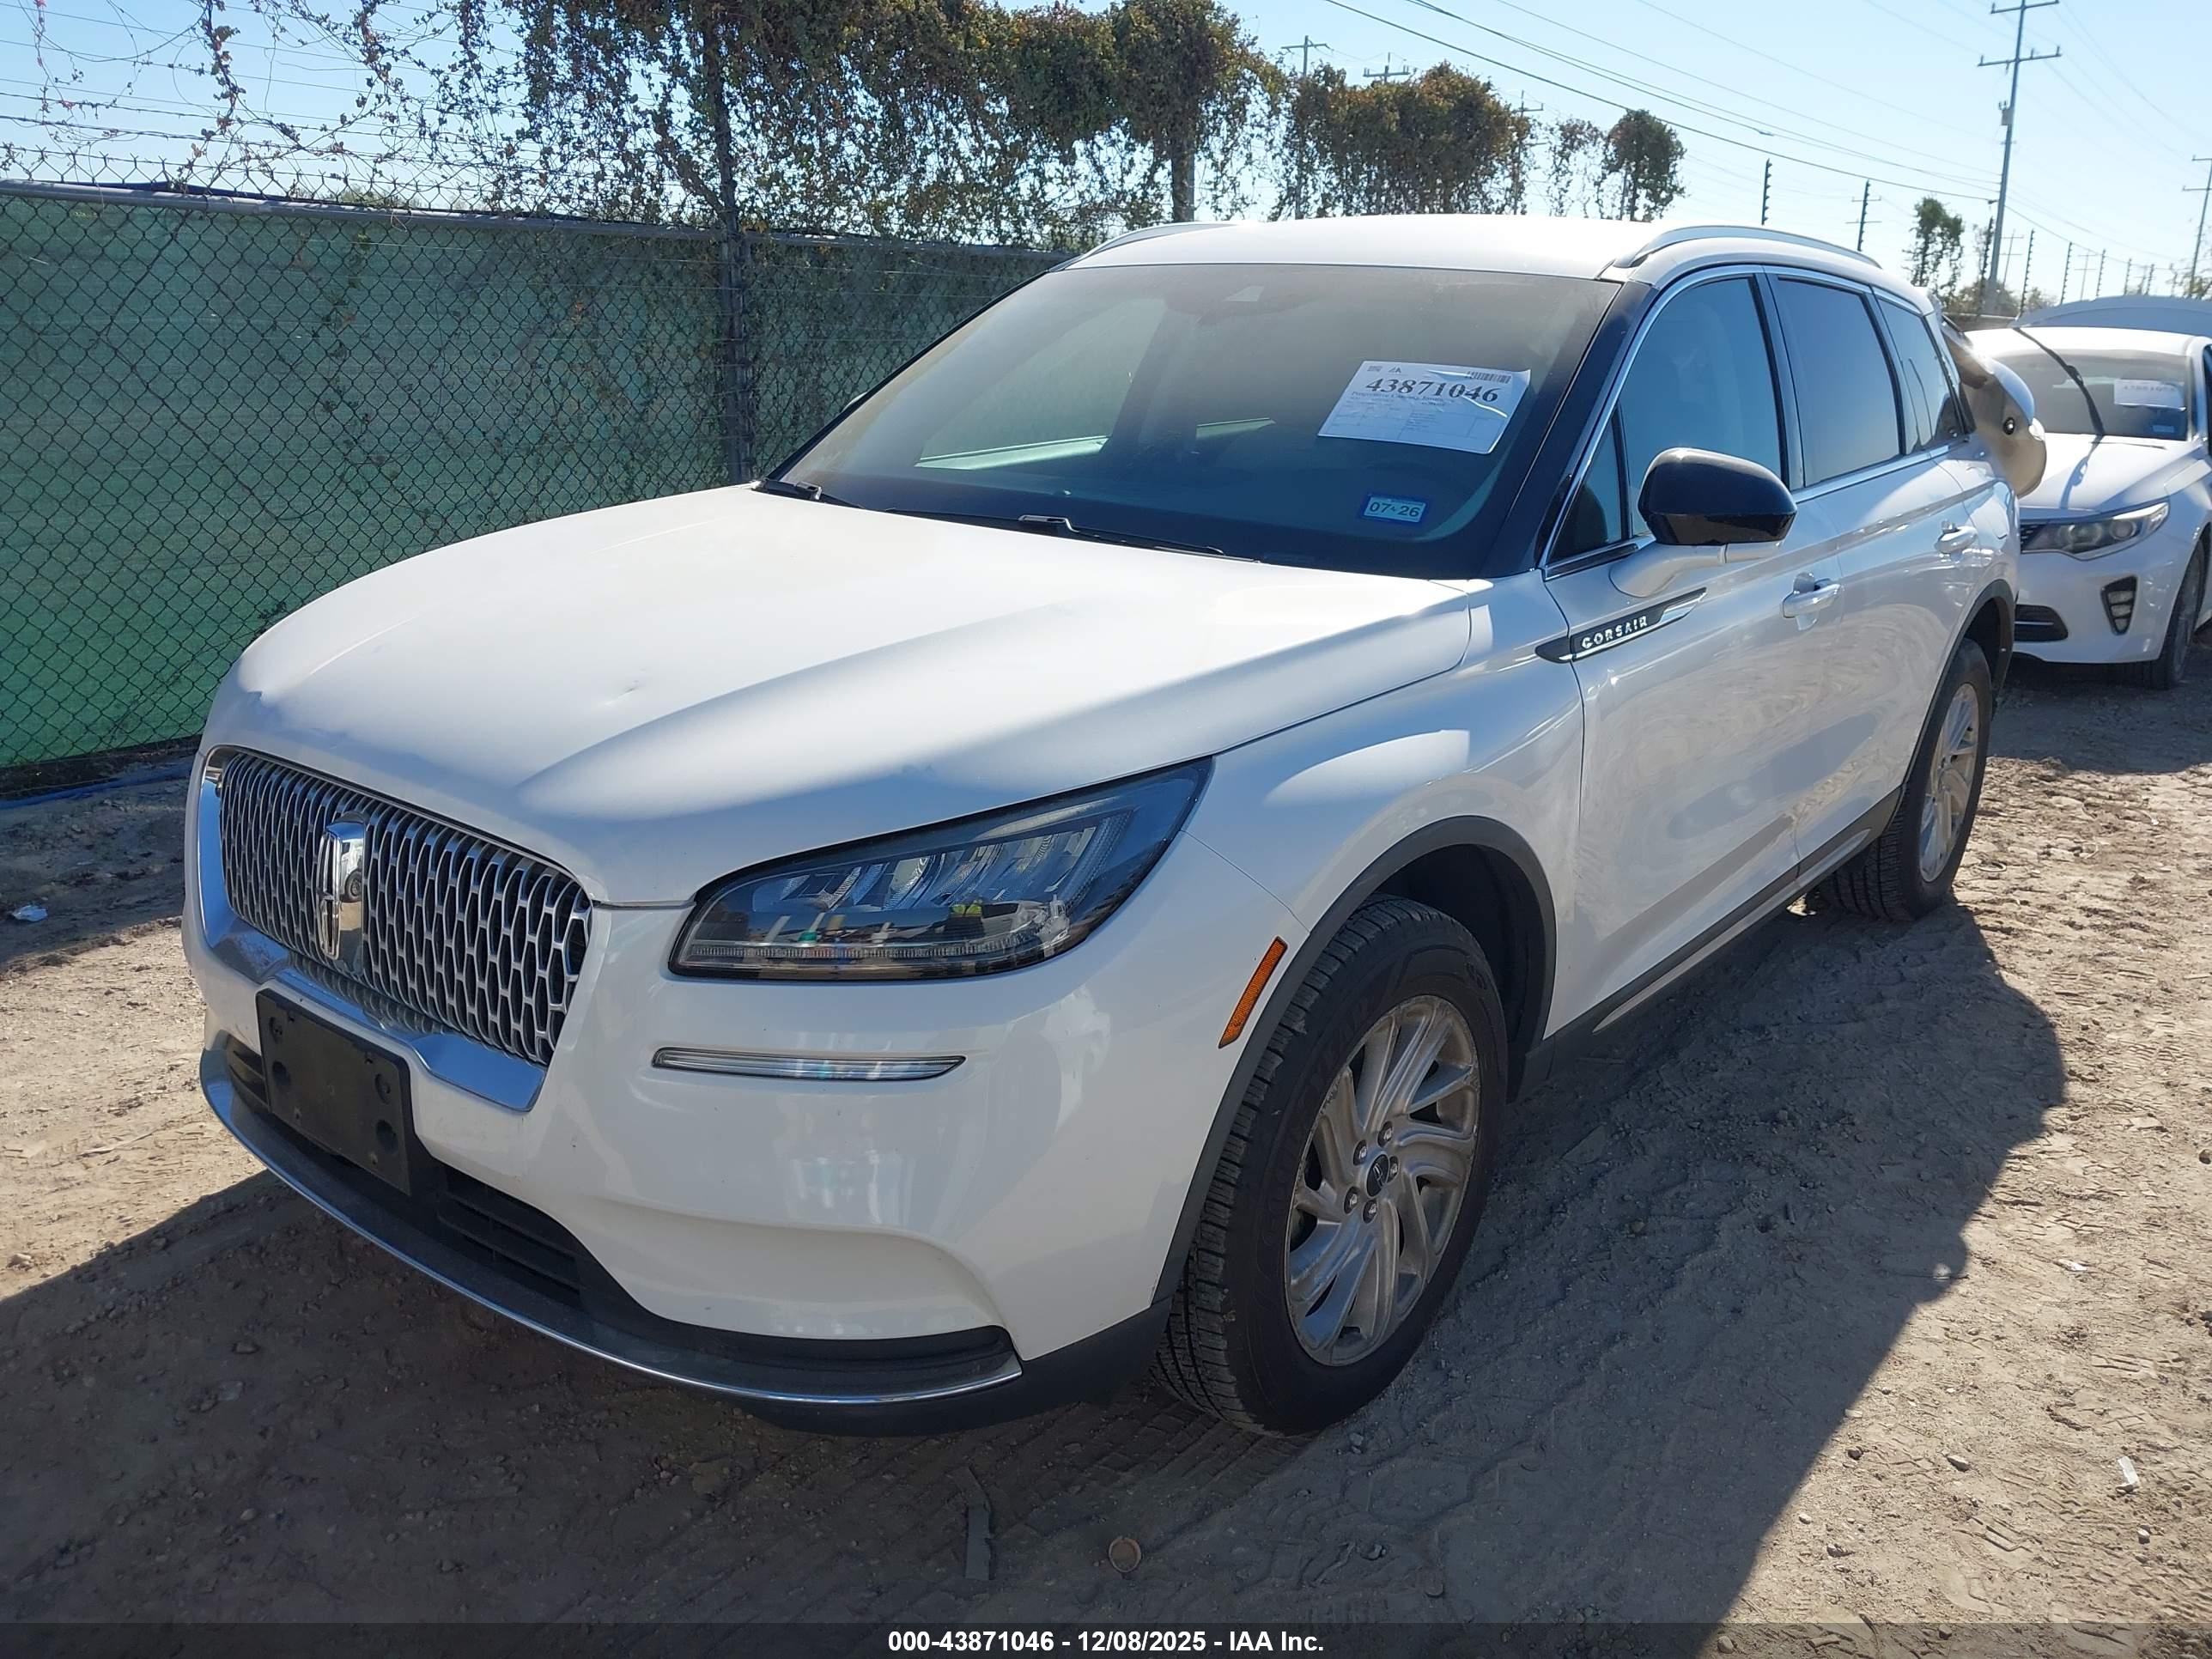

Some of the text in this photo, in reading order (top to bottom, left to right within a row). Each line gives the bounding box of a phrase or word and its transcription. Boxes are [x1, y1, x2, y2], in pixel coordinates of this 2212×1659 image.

[1365, 378, 1500, 403] 43871046
[1370, 501, 1420, 517] 07 26
[1581, 616, 1648, 649] CORSAIR
